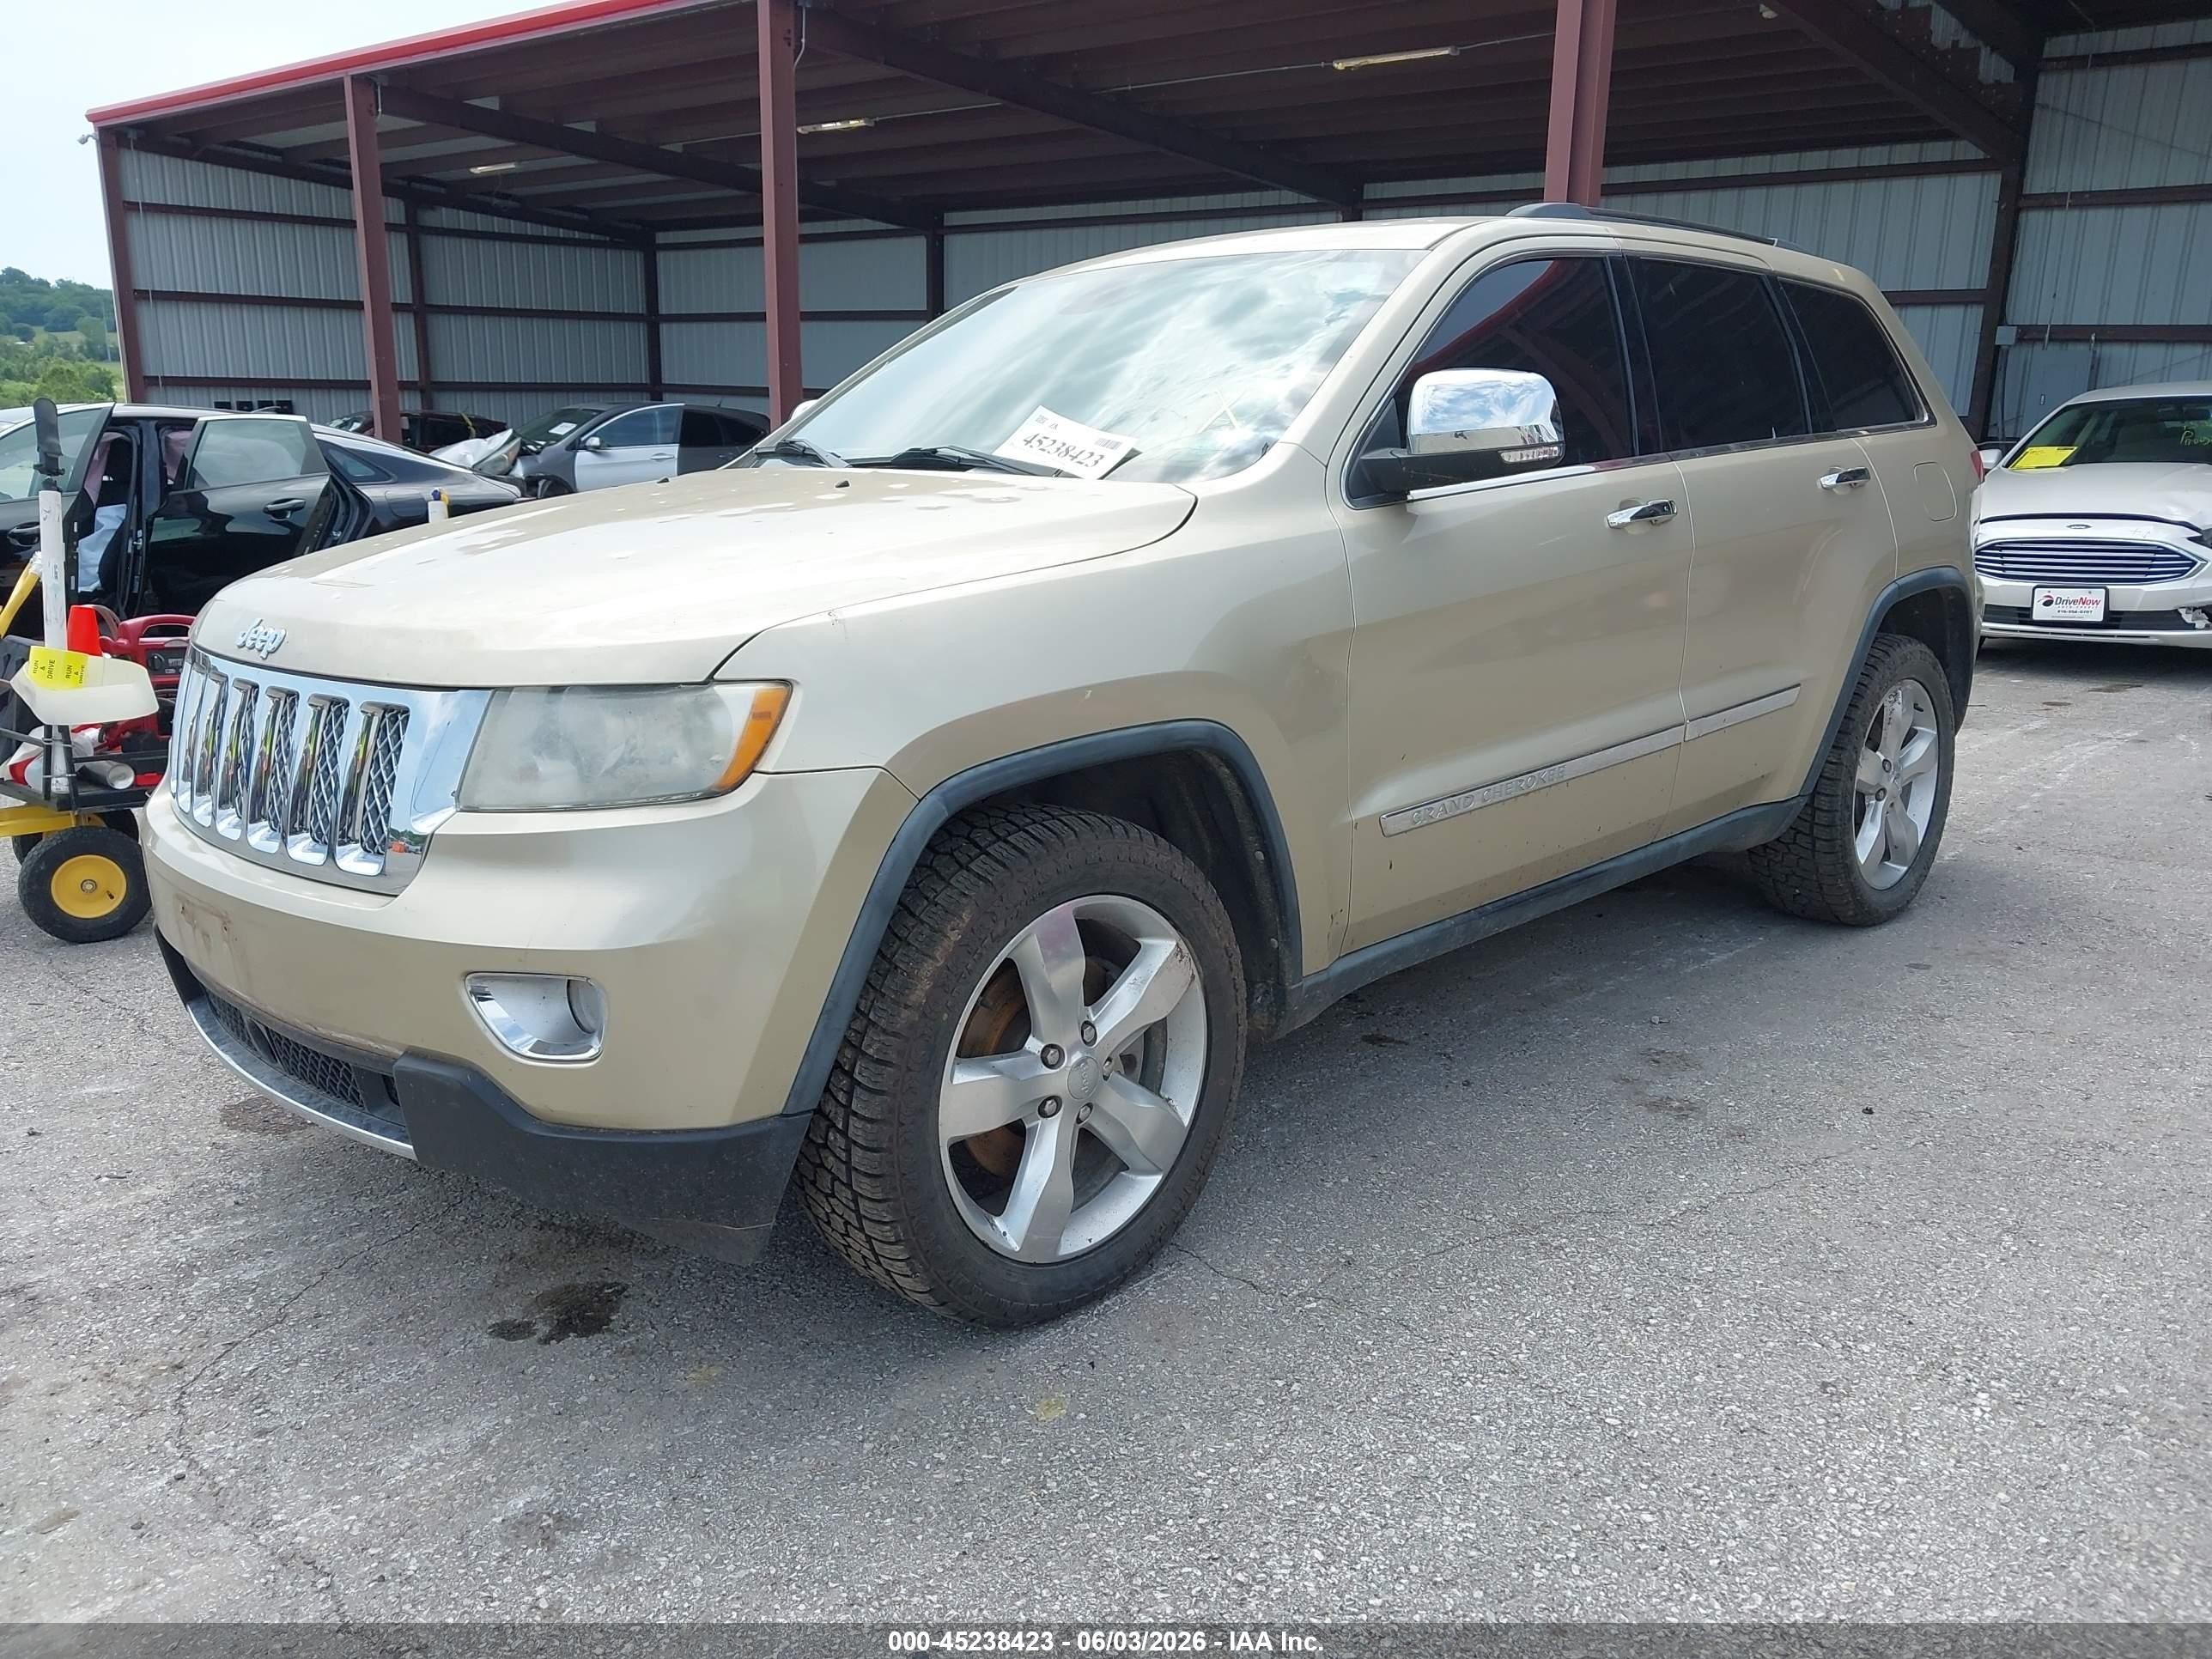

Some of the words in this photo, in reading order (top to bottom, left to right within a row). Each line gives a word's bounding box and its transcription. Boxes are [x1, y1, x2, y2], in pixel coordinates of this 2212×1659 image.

[1023, 433, 1105, 468] 45238423
[2055, 596, 2101, 606] DriveNow
[236, 617, 287, 660] Jeep
[46, 659, 56, 679] DRIVE
[1412, 793, 1475, 825] GRAND
[1482, 764, 1567, 803] CHEROKEE
